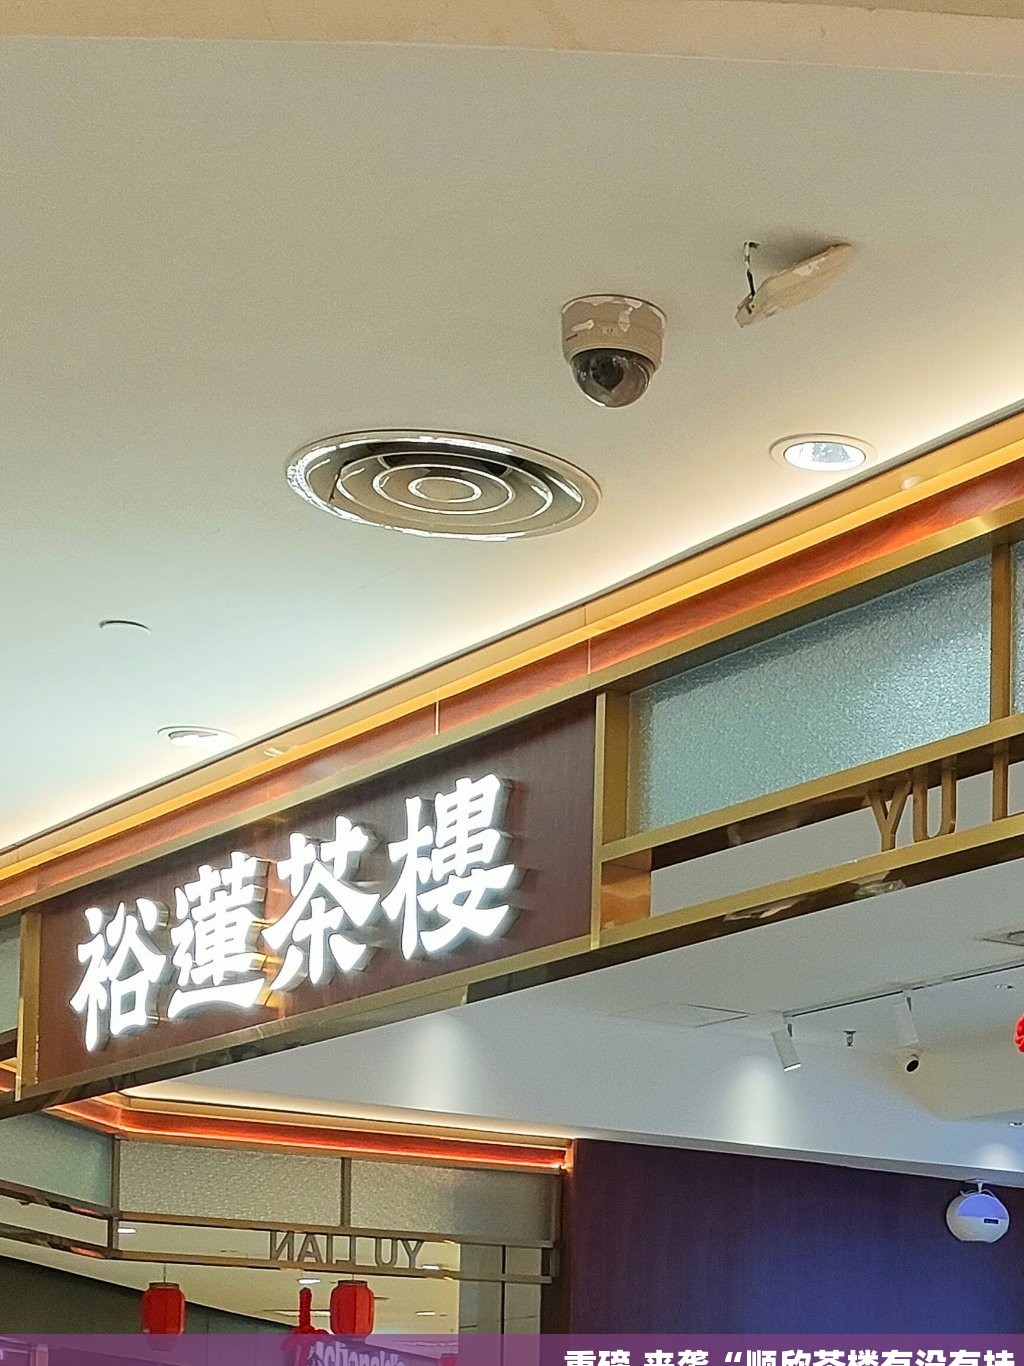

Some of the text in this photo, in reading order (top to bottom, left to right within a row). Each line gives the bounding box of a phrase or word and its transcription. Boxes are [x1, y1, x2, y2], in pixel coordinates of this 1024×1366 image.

[864, 755, 956, 852] YU
[70, 773, 517, 1053] 裕蓮茶樓
